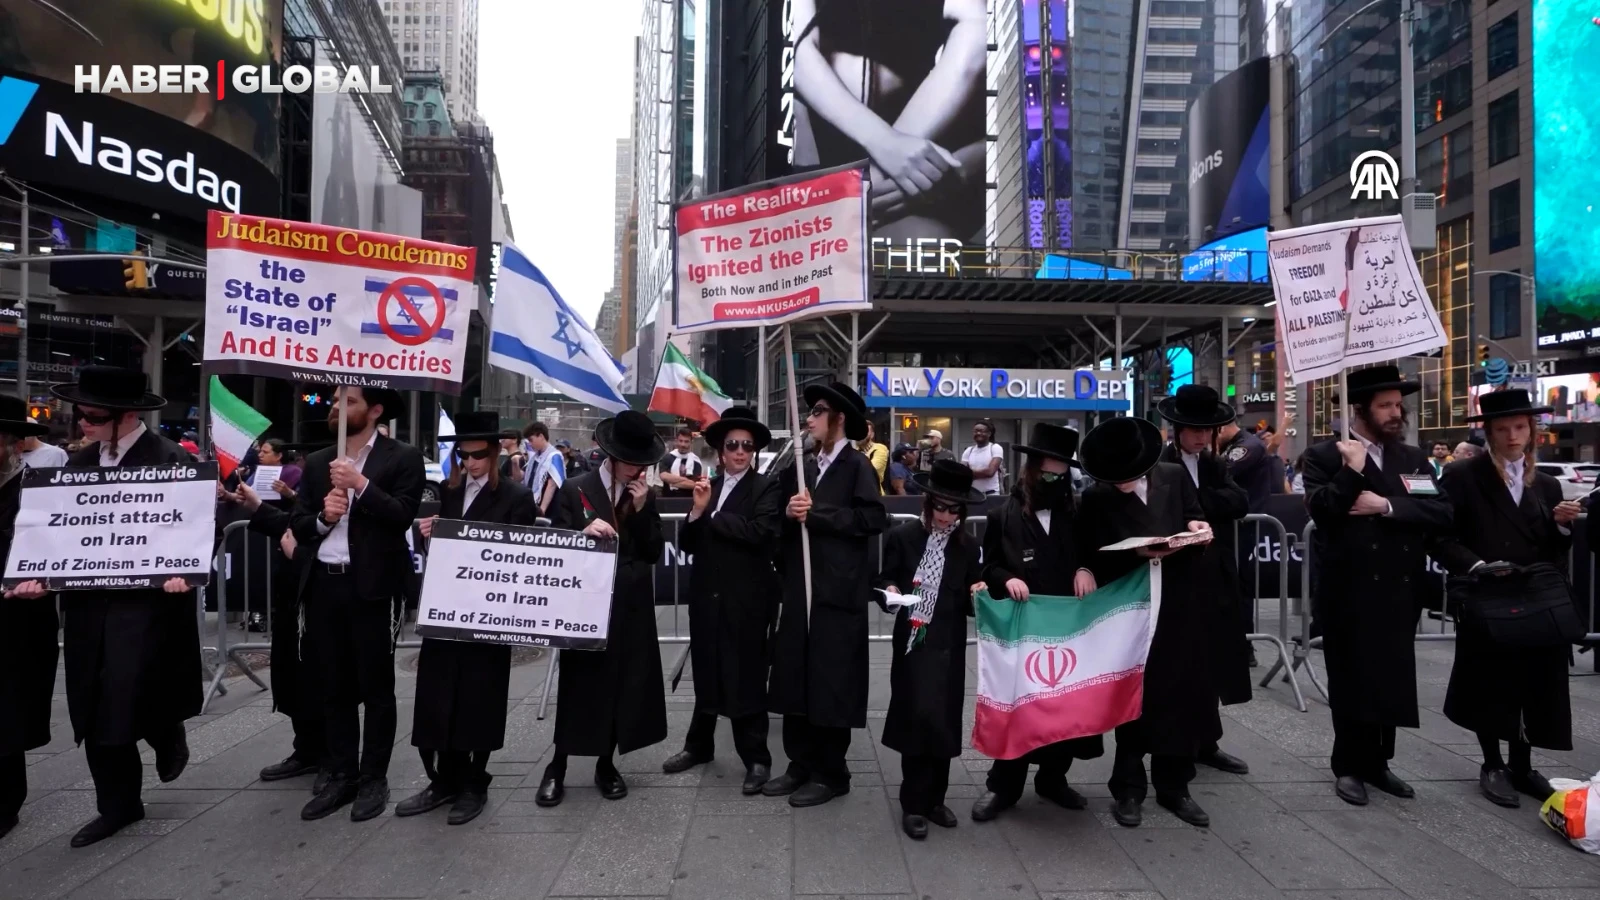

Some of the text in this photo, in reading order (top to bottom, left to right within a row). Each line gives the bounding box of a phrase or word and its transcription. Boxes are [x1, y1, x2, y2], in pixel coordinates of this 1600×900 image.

[45, 111, 241, 211] Nasdaq
[701, 185, 830, 222] The Reality...
[217, 215, 467, 270] Judaism Condemns
[701, 215, 833, 253] The Zionists
[1302, 241, 1332, 255] Demands
[688, 237, 849, 284] Ignited the Fire
[260, 259, 306, 284] the
[701, 264, 833, 299] Both Now and in the Past
[1288, 263, 1326, 280] FREEDOM
[224, 279, 336, 313] State of
[724, 293, 811, 316] www.NKUSA.org
[1290, 287, 1337, 307] for GAZA and
[1399, 289, 1417, 308] كل
[40, 313, 81, 324] REWRITE
[1288, 309, 1346, 333] ALL PALESTINE
[221, 331, 452, 374] And its Atrocities
[292, 370, 389, 389] www.NKUSA.org
[1242, 392, 1276, 403] CHASE
[1285, 428, 1297, 436] 3
[50, 466, 198, 484] Jews worldwide
[76, 491, 164, 505] Condemn
[48, 509, 183, 527] Zionist attack
[81, 532, 147, 547] on Iran
[457, 525, 596, 549] Jews worldwide
[17, 559, 47, 571] End
[51, 559, 68, 571] of
[72, 558, 135, 571] Zionism
[141, 559, 150, 567] =
[155, 556, 200, 569] Peace
[480, 548, 564, 568] Condemn
[65, 577, 150, 587] www.NKUSA.org
[455, 566, 583, 589] Zionist attack
[485, 591, 549, 606] on Iran
[427, 608, 598, 633] End of Zionism = Peace
[473, 631, 550, 645] www.NKUSA.org
